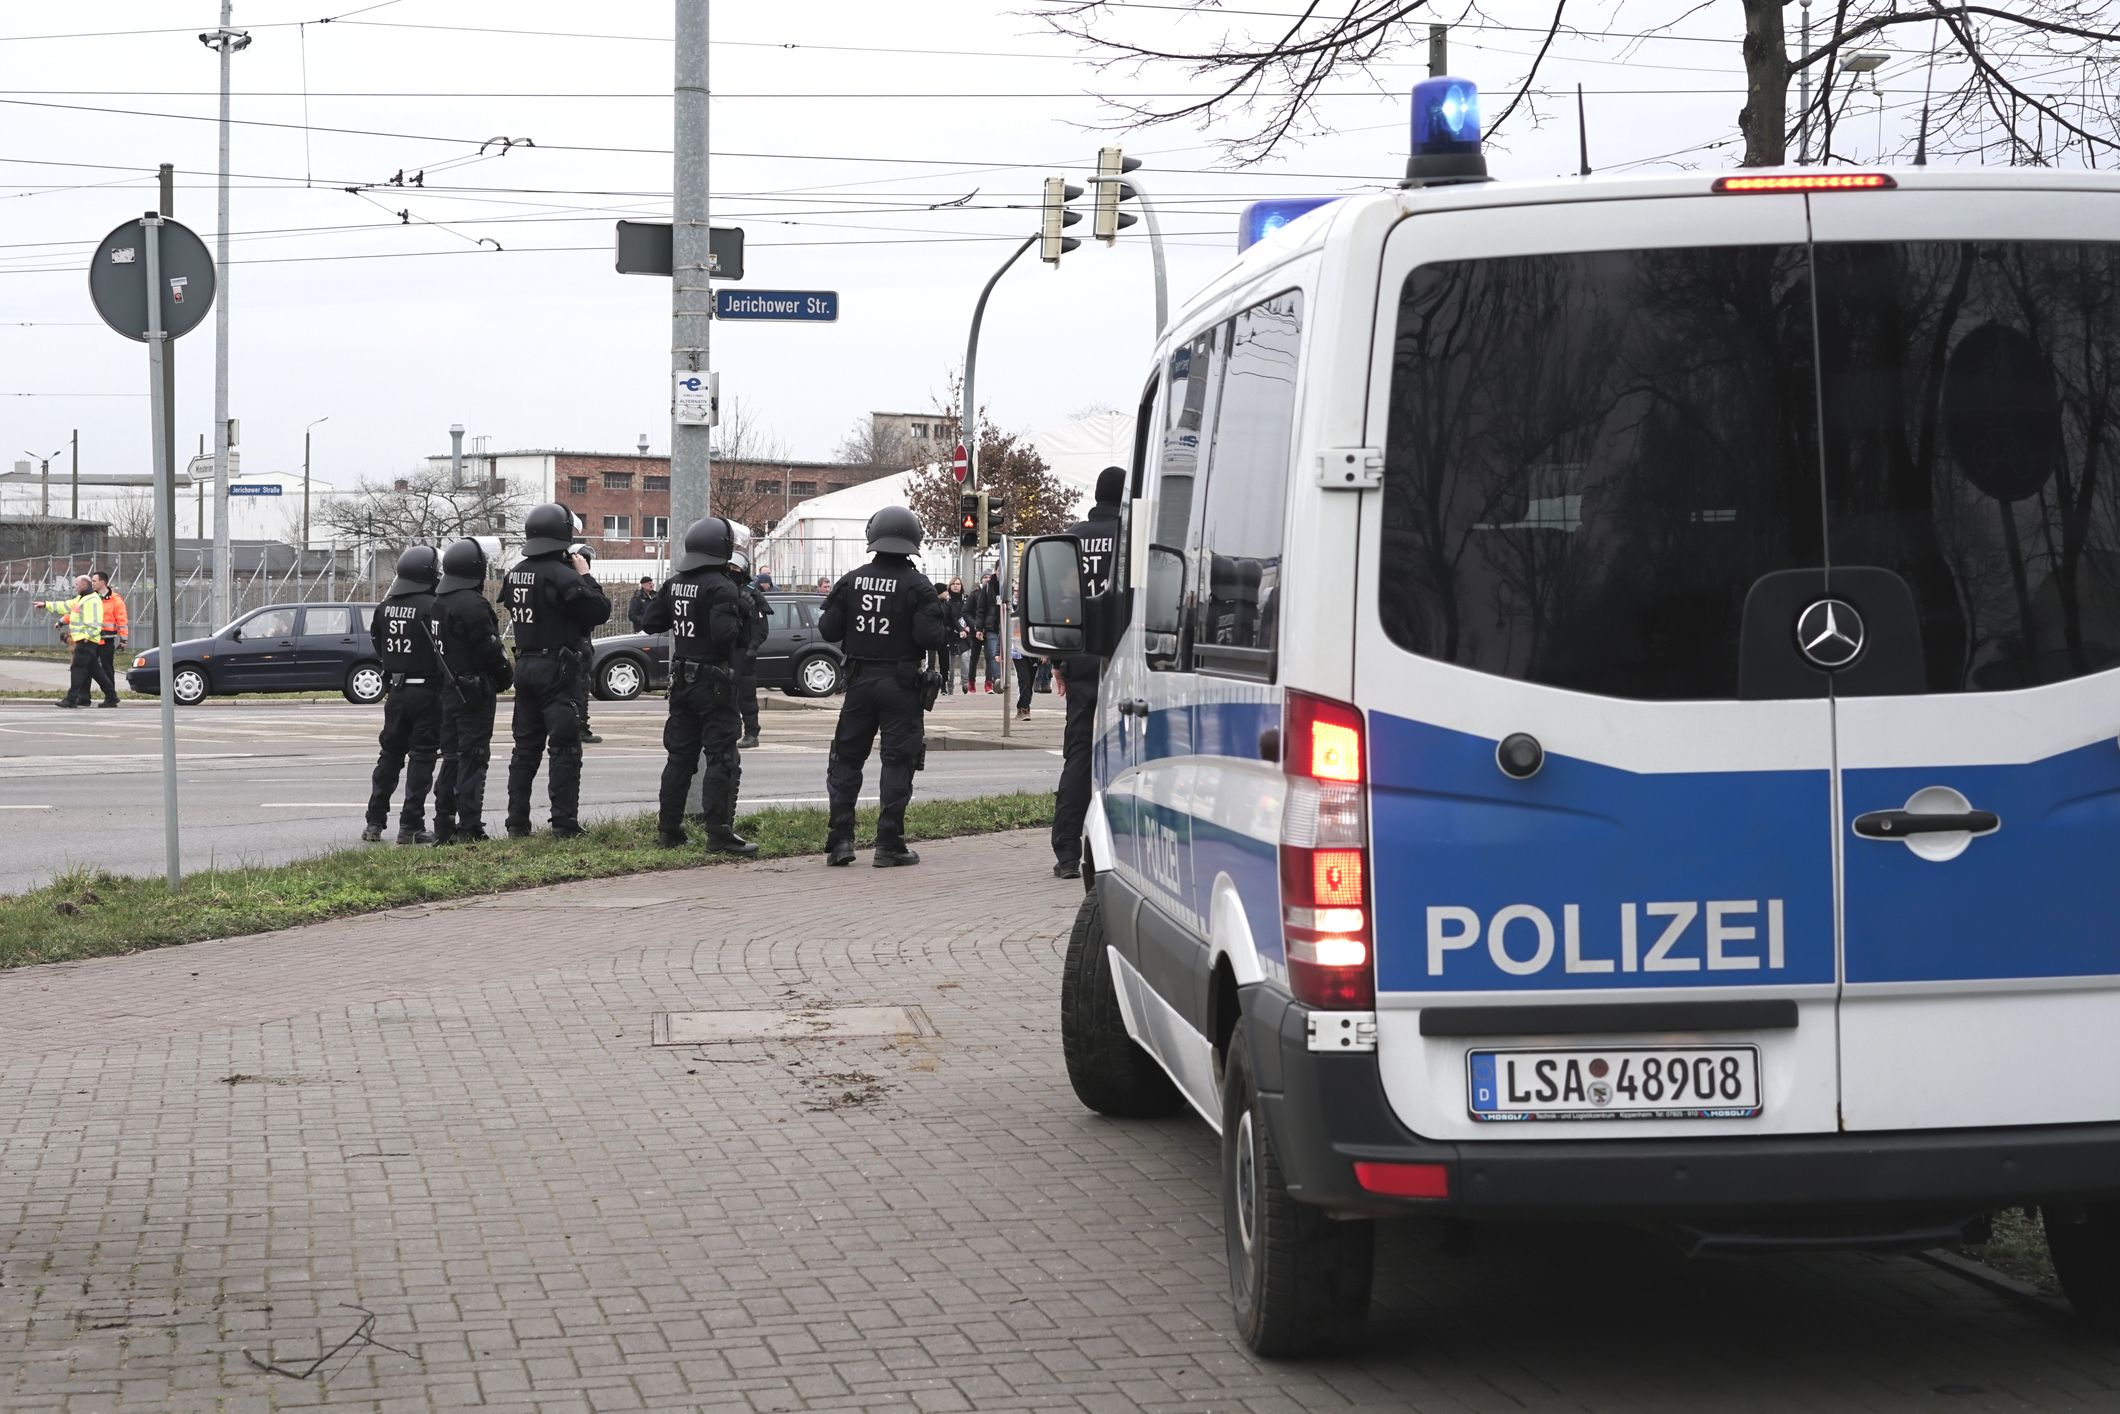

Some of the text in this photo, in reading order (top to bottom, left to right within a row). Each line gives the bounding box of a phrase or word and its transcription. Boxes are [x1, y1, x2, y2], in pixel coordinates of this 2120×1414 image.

[725, 296, 830, 314] Jerichower Str.
[232, 486, 281, 494] Jerichower Straße
[1082, 556, 1102, 574] ST
[508, 571, 536, 585] POLIZEI
[854, 576, 897, 593] POLIZEI
[513, 588, 529, 604] ST
[670, 583, 699, 598] POLIZEI
[674, 599, 690, 616] ST
[861, 594, 886, 613] ST
[384, 605, 417, 619] POLIZEI
[512, 607, 533, 624] 312
[389, 620, 407, 635] ST
[431, 620, 440, 636] ST
[673, 619, 695, 638] 312
[855, 615, 890, 635] 312
[387, 638, 412, 653] 312
[1426, 898, 1785, 976] POLIZEI
[1507, 1056, 1742, 1103] LSA 48908
[1479, 1088, 1490, 1101] D
[1710, 1109, 1745, 1117] MOSOLF
